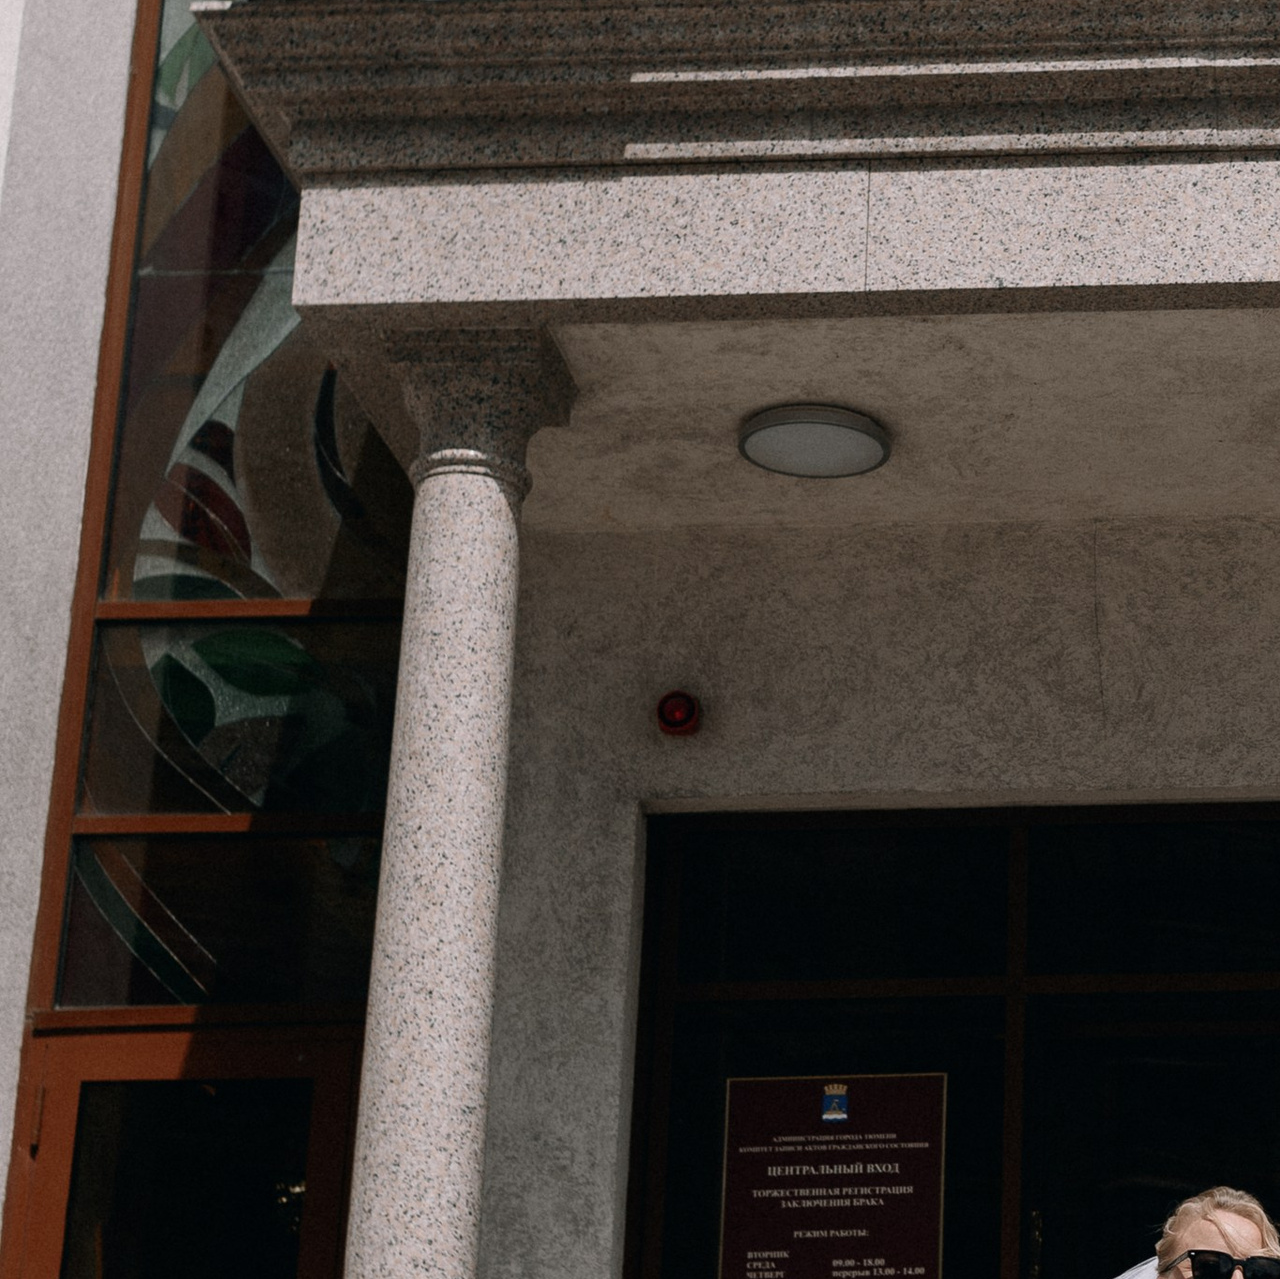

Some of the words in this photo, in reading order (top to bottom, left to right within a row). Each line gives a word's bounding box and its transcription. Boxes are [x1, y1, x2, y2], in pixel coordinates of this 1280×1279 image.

[767, 1162, 864, 1176] ЦЕНТРАЛЬНЫЙ
[866, 1163, 900, 1174] ВХОД
[752, 1187, 840, 1198] ТОРЖЕСТВЕННАЯ
[842, 1185, 914, 1196] РЕГИСТРАЦИЯ
[781, 1198, 851, 1208] ЗАКЛЮЧЕНИЯ
[852, 1197, 885, 1207] БРАКА
[793, 1229, 828, 1238] РЕЖИМ
[829, 1228, 870, 1237] РАБОТЫ:
[746, 1250, 790, 1259] ВТОРНИК
[746, 1261, 776, 1269] СРЕДА
[831, 1259, 856, 1267] 09.00
[746, 1271, 785, 1279] ЧЕТВЕРГ
[831, 1269, 871, 1279] перерыв
[872, 1268, 896, 1276] 13.00
[903, 1267, 926, 1276] 14.00
